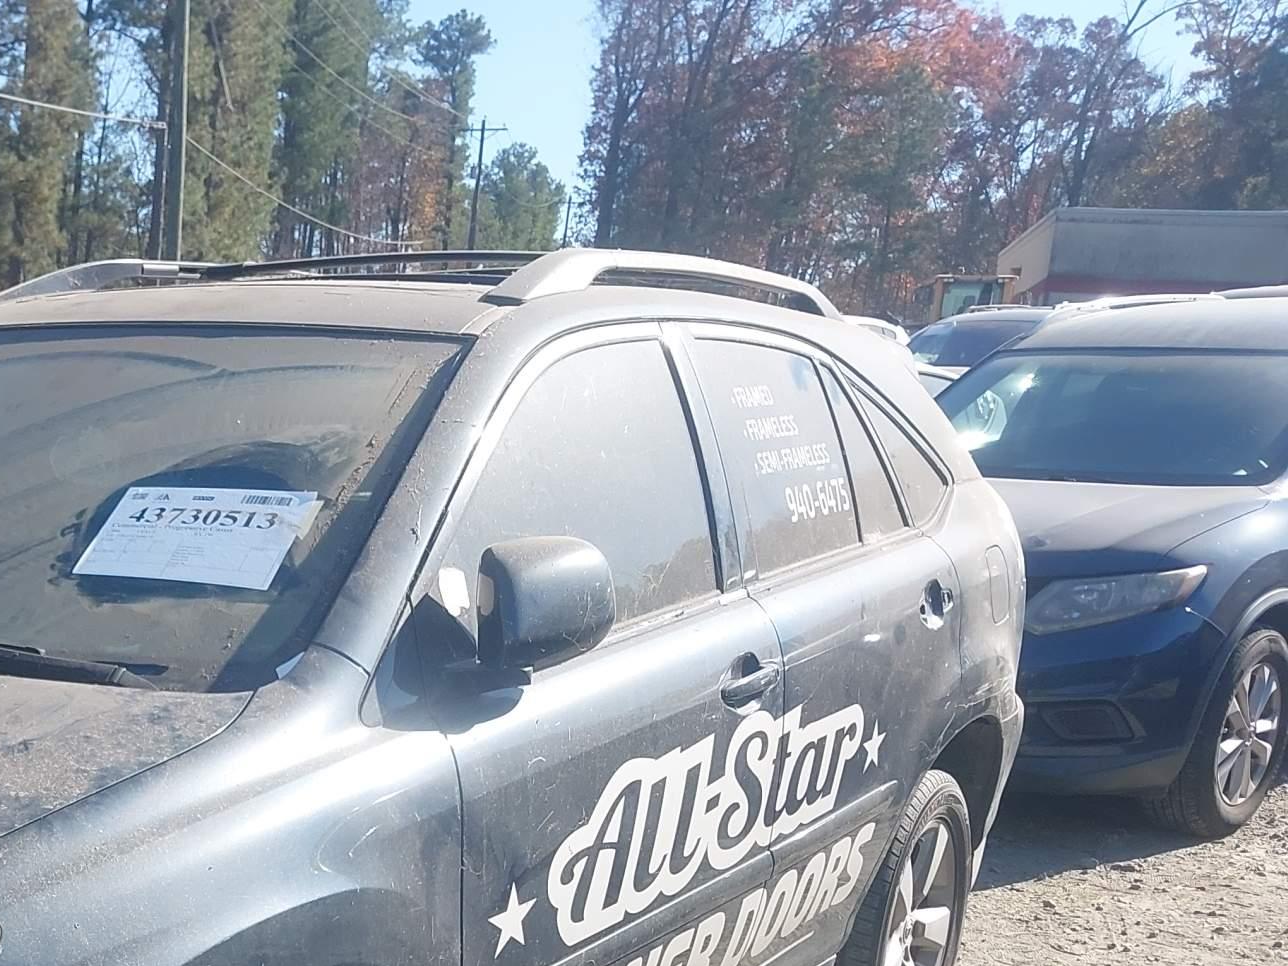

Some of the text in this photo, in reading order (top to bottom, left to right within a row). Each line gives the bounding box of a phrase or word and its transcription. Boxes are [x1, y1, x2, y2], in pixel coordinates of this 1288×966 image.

[733, 386, 774, 408] FRAMED
[746, 416, 798, 440] FRAMELESS
[757, 444, 830, 474] SEMI-FRAMELESS
[785, 478, 849, 522] 940-6475
[128, 506, 279, 529] 43730513
[548, 704, 865, 947] All-Star
